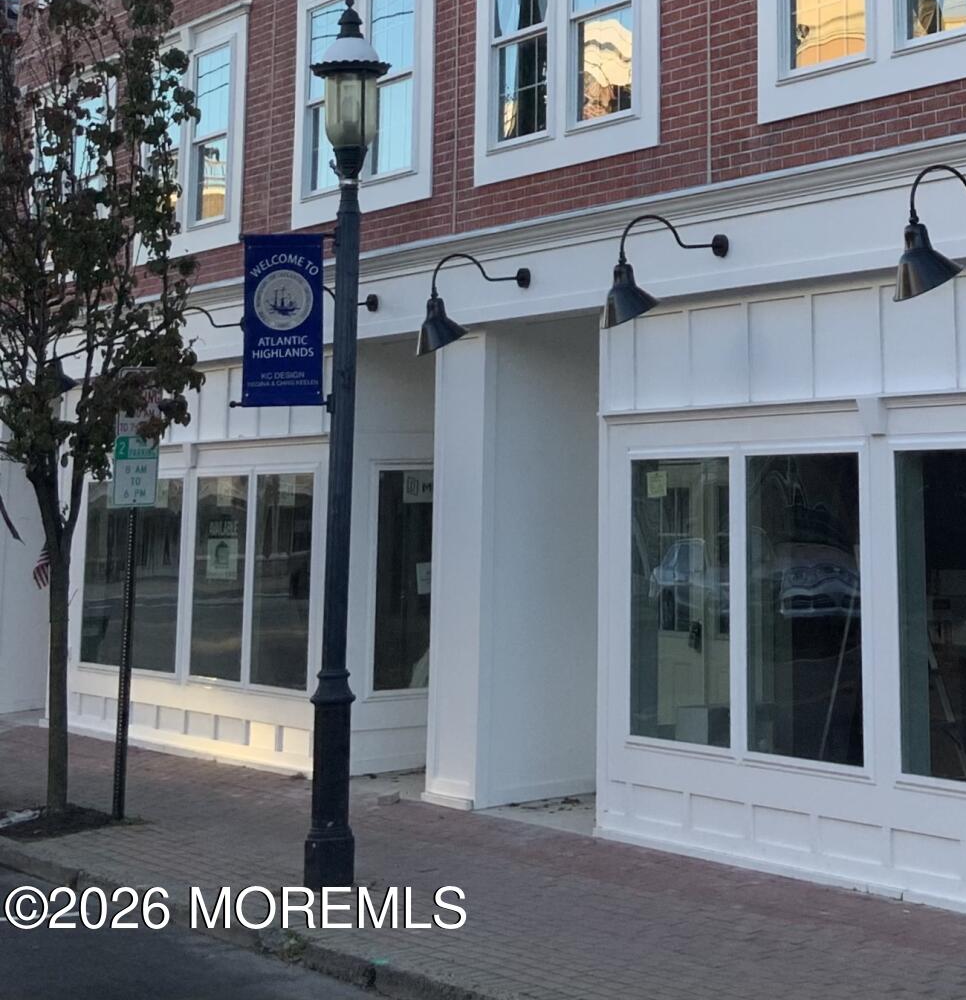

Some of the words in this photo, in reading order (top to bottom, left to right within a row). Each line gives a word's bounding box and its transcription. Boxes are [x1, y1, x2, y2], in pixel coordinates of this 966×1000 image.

[250, 253, 305, 278] WELCOME
[305, 262, 320, 277] TO
[257, 335, 309, 347] ATLANTIC
[252, 347, 315, 359] HIGHLANDS
[274, 371, 305, 379] DESIGN
[119, 441, 126, 455] 2
[135, 464, 147, 473] AM
[131, 477, 141, 486] TO
[134, 489, 146, 498] PM
